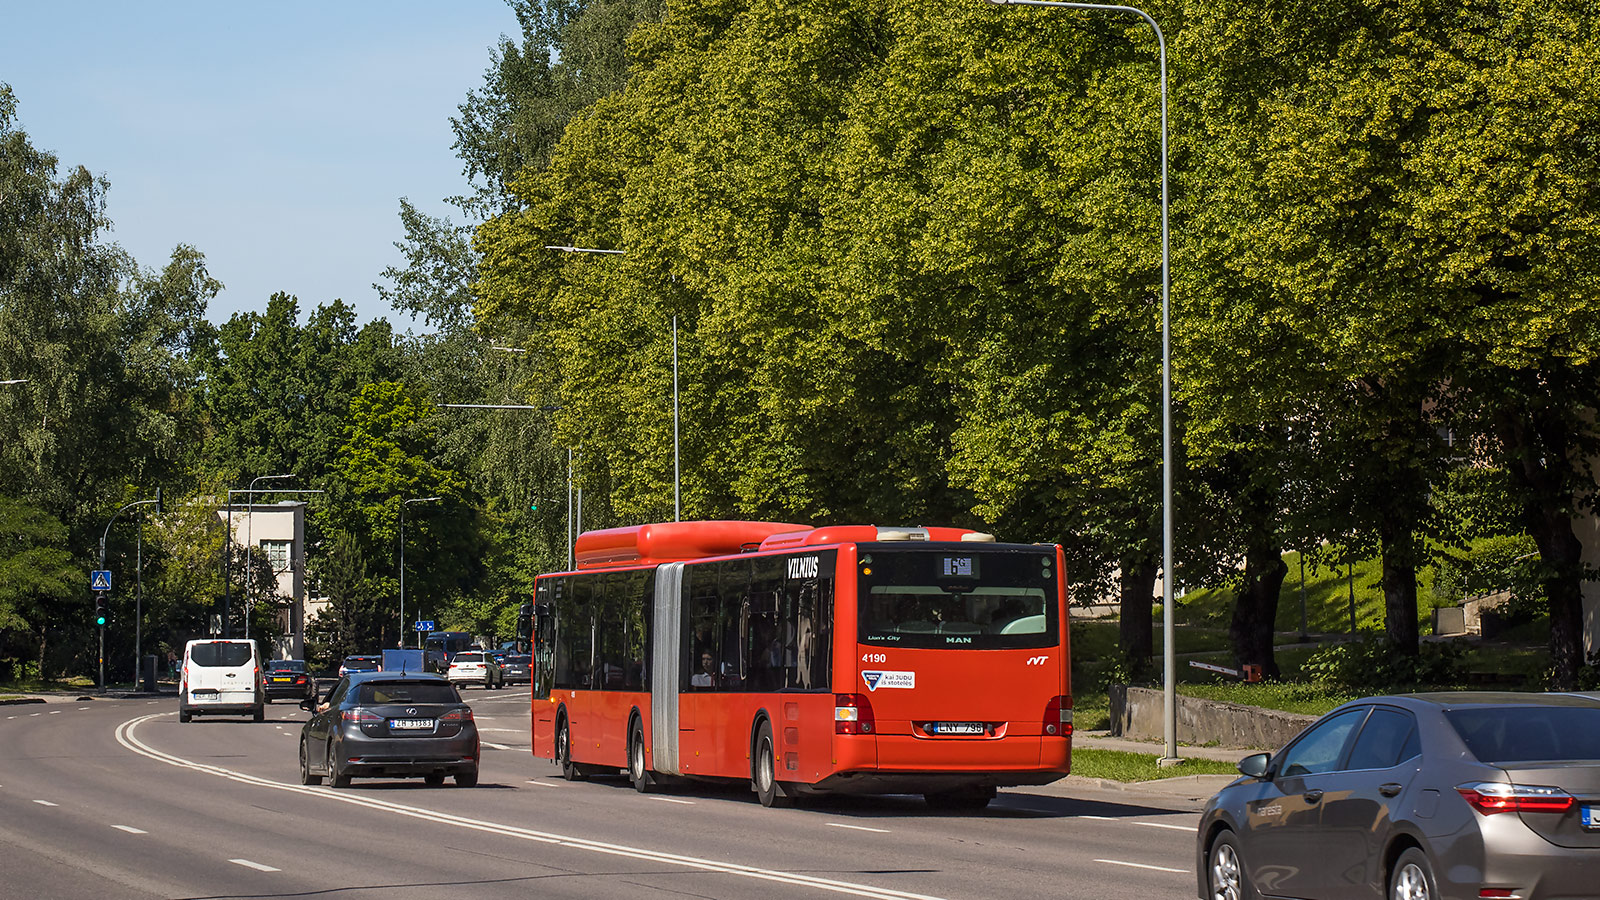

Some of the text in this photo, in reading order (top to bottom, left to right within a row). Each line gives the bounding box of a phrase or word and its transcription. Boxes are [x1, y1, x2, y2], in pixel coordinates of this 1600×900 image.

[788, 556, 819, 579] VILNIUS
[887, 633, 901, 641] City
[862, 653, 886, 663] 4190
[939, 723, 958, 732] LNY
